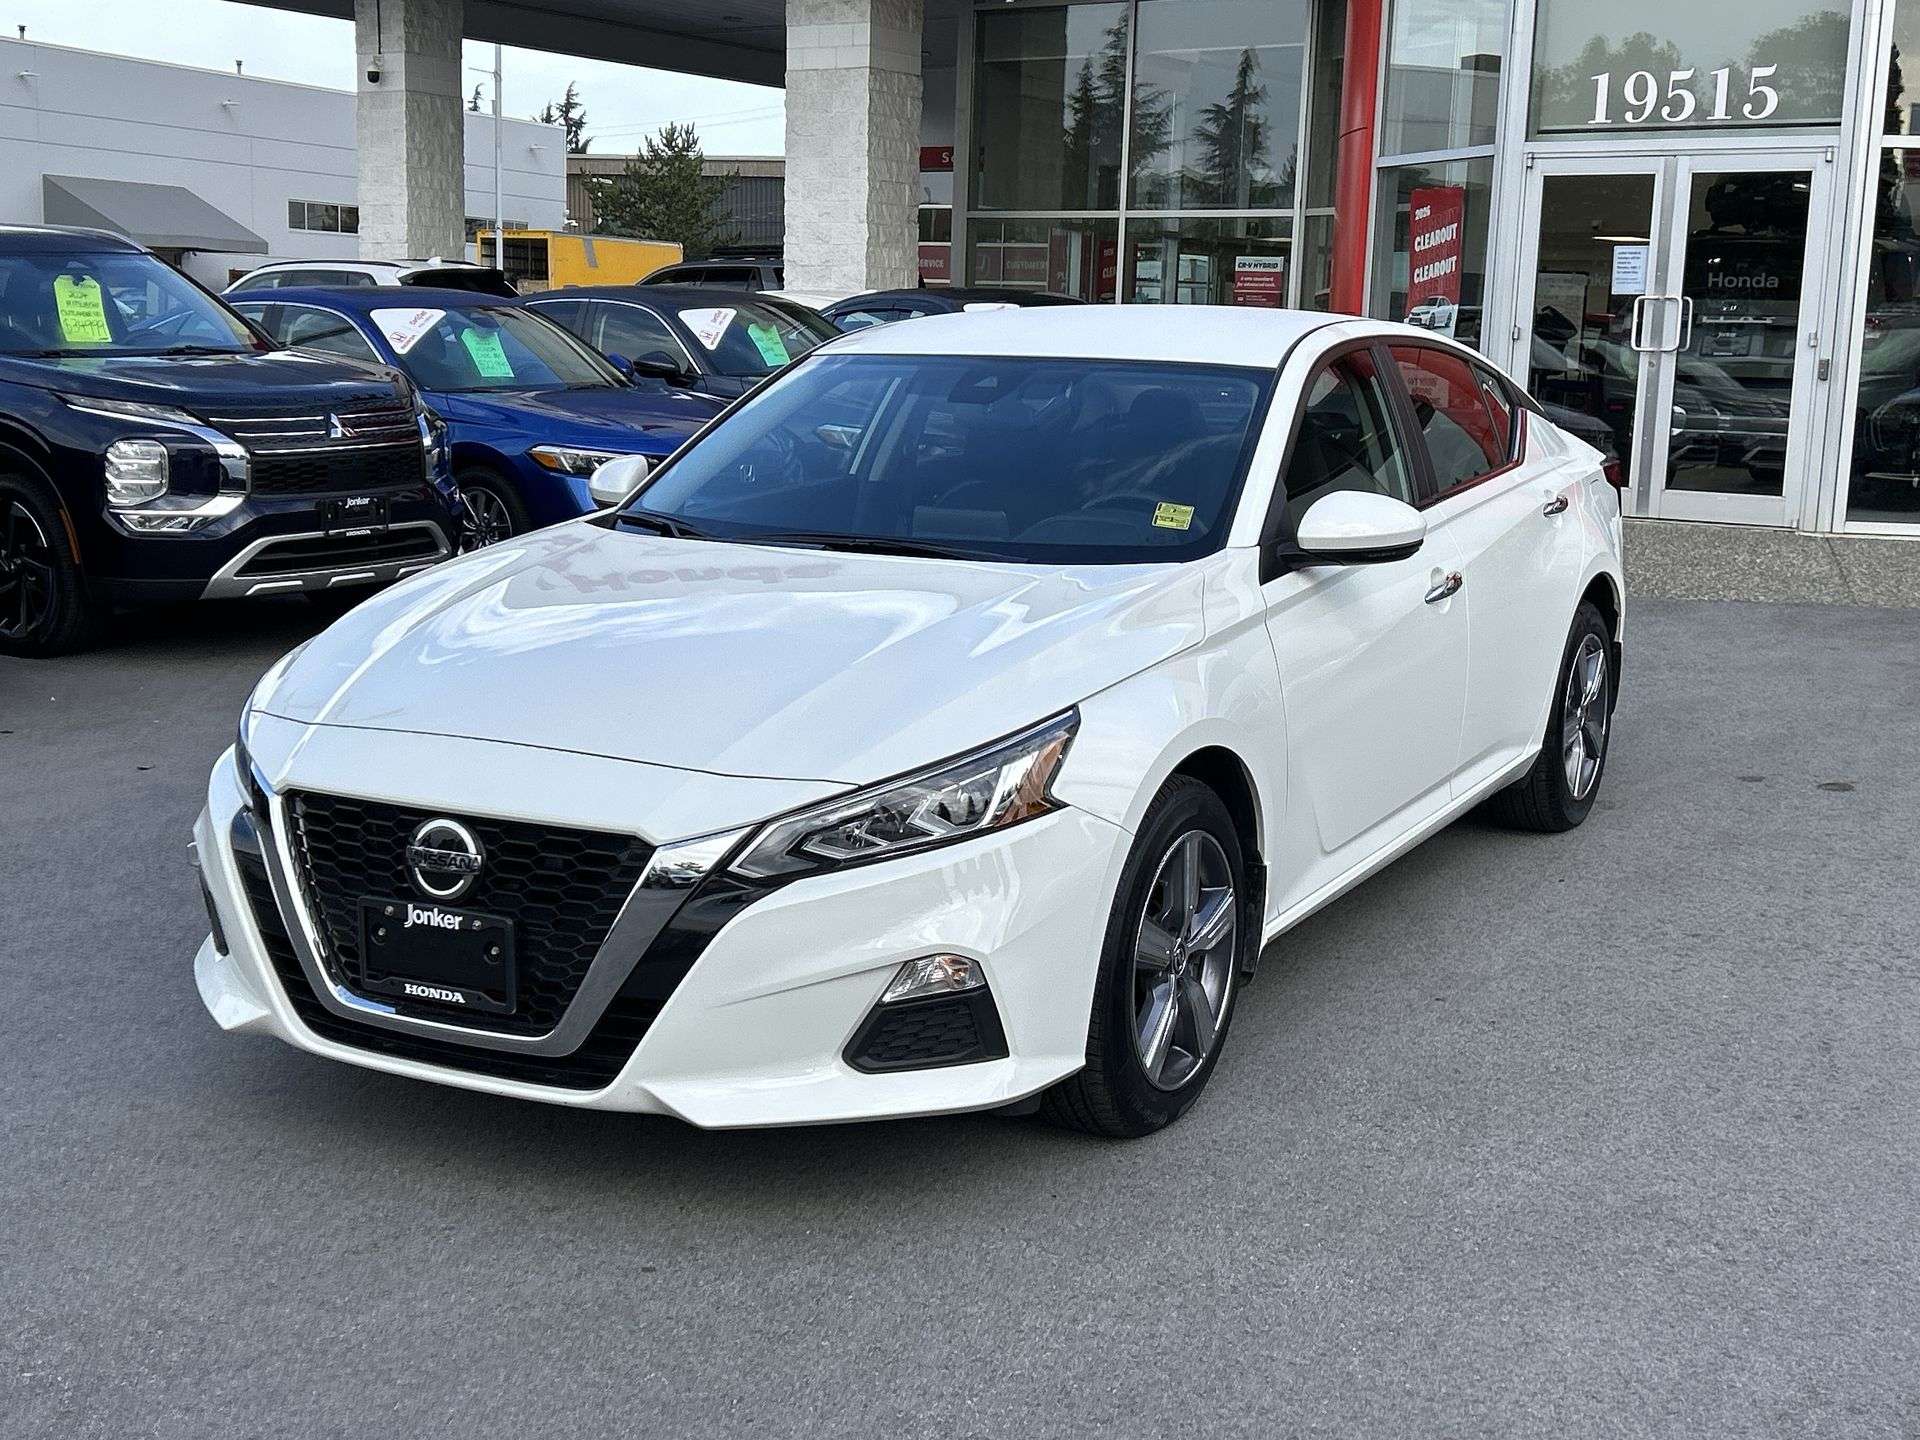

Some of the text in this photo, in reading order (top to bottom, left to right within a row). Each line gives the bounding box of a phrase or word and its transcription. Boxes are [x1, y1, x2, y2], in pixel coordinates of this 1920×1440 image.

[1588, 63, 1779, 124] 19515
[1415, 223, 1458, 252] CLEAROUT
[1414, 256, 1457, 284] CLEAROUT
[1707, 271, 1779, 289] Honda
[345, 497, 370, 509] Jonker
[408, 849, 474, 871] NISSAN
[404, 904, 464, 930] Jonker
[404, 983, 466, 1004] HONDA
